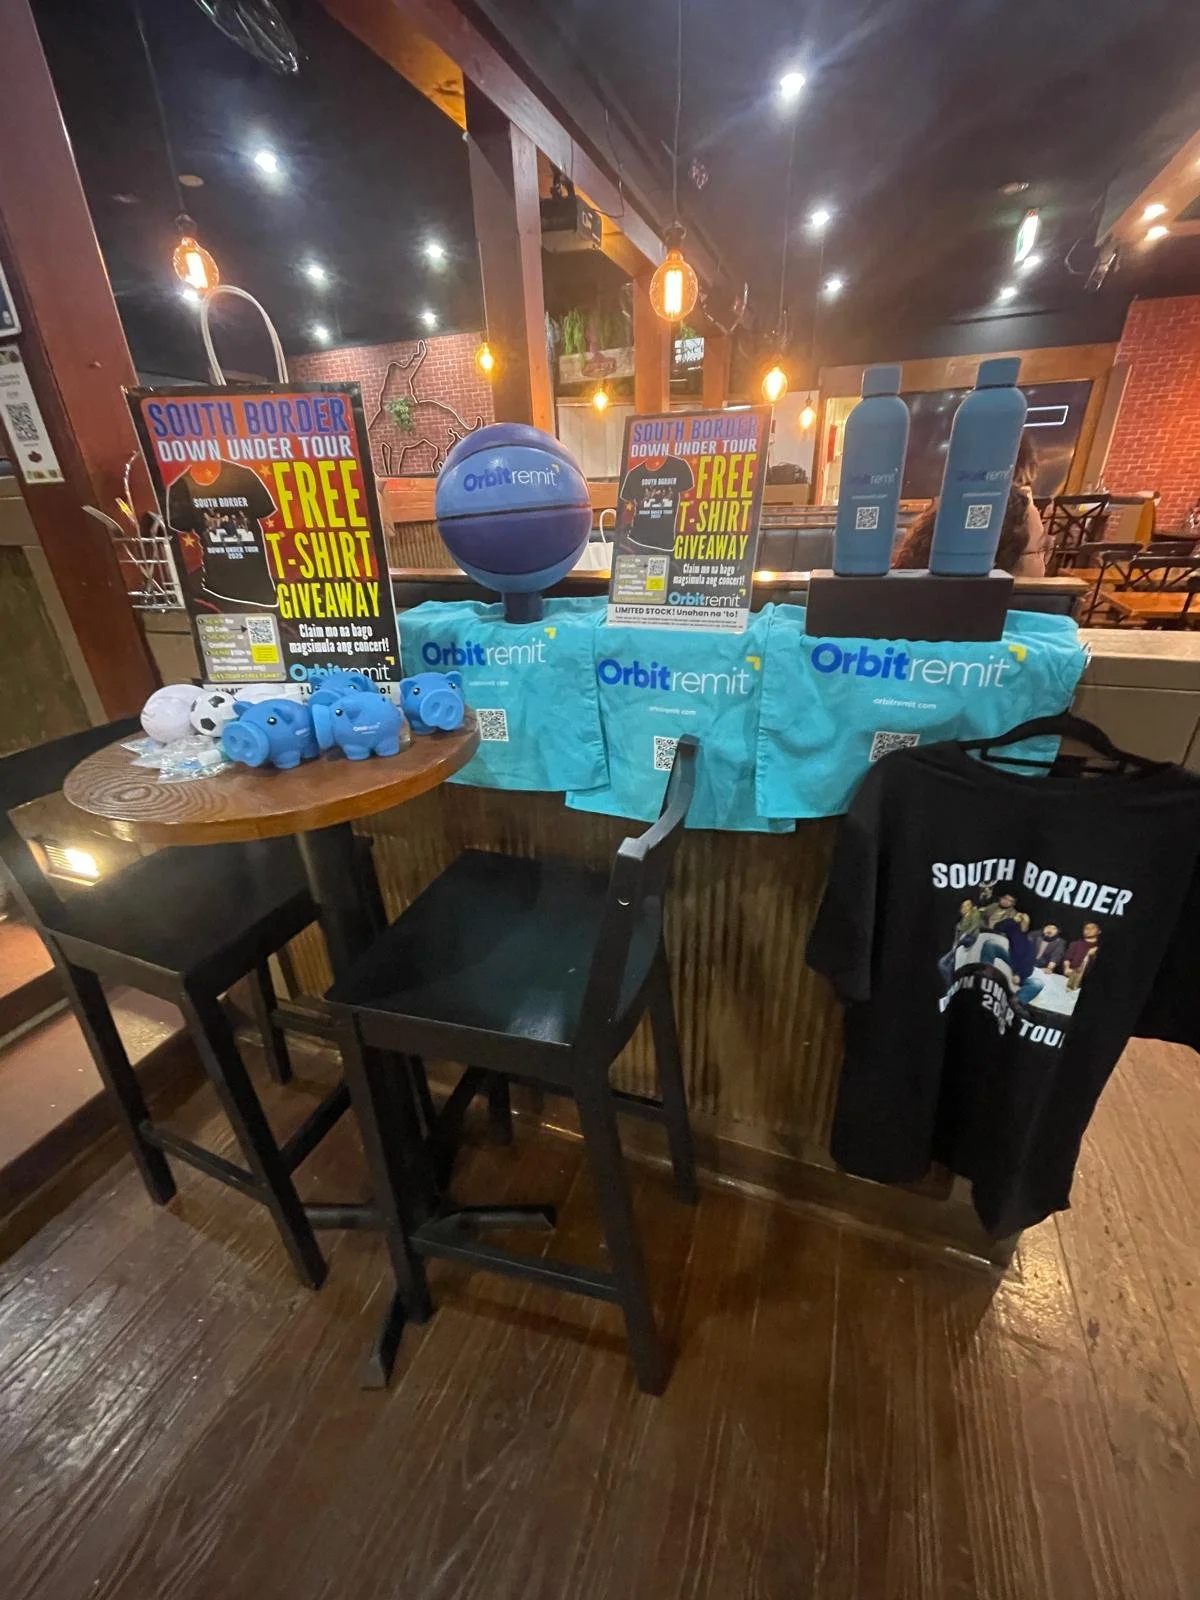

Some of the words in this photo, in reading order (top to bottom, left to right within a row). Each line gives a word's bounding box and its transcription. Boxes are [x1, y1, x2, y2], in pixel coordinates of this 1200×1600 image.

[147, 402, 238, 438] SOUTH
[244, 397, 349, 435] BORDER
[633, 421, 685, 443] SOUTH
[690, 416, 759, 440] BORDER
[157, 440, 222, 463] DOWN
[227, 438, 293, 460] UNDER
[299, 435, 354, 458] TOUR
[631, 441, 669, 458] DOWN
[674, 440, 717, 455] UNDER
[722, 438, 757, 453] TOUR
[463, 466, 557, 492] Orbitremit
[695, 454, 757, 499] FREE
[193, 497, 219, 508] SOUTH
[218, 496, 249, 508] BORDER
[272, 460, 368, 529] FREE
[679, 500, 753, 533] T-SHIRT
[264, 531, 374, 579] T-SHIRT
[673, 535, 749, 561] GIVEAWAY
[673, 575, 705, 586] magsimula
[706, 577, 718, 587] ang
[718, 575, 745, 586] concert!
[683, 563, 700, 574] Claim
[719, 564, 735, 576] bago
[277, 582, 380, 619] GIVEAWAY
[615, 606, 644, 615] LIMITED
[646, 607, 675, 616] STOCK!
[676, 608, 709, 617] Unahan
[668, 591, 740, 607] Orbitremit
[298, 623, 324, 638] Claim
[325, 627, 338, 637] mo
[339, 627, 351, 637] na
[351, 623, 373, 640] bago
[289, 639, 335, 656] magsimula
[336, 641, 353, 656] ang
[353, 638, 390, 653] concert!
[422, 636, 547, 667] Orbitremit
[598, 658, 749, 695] Orbitremit
[811, 642, 1011, 688] Orbitremit
[931, 858, 1017, 890] SOUTH
[1022, 860, 1134, 917] BORDER
[1018, 1018, 1066, 1049] TOU
